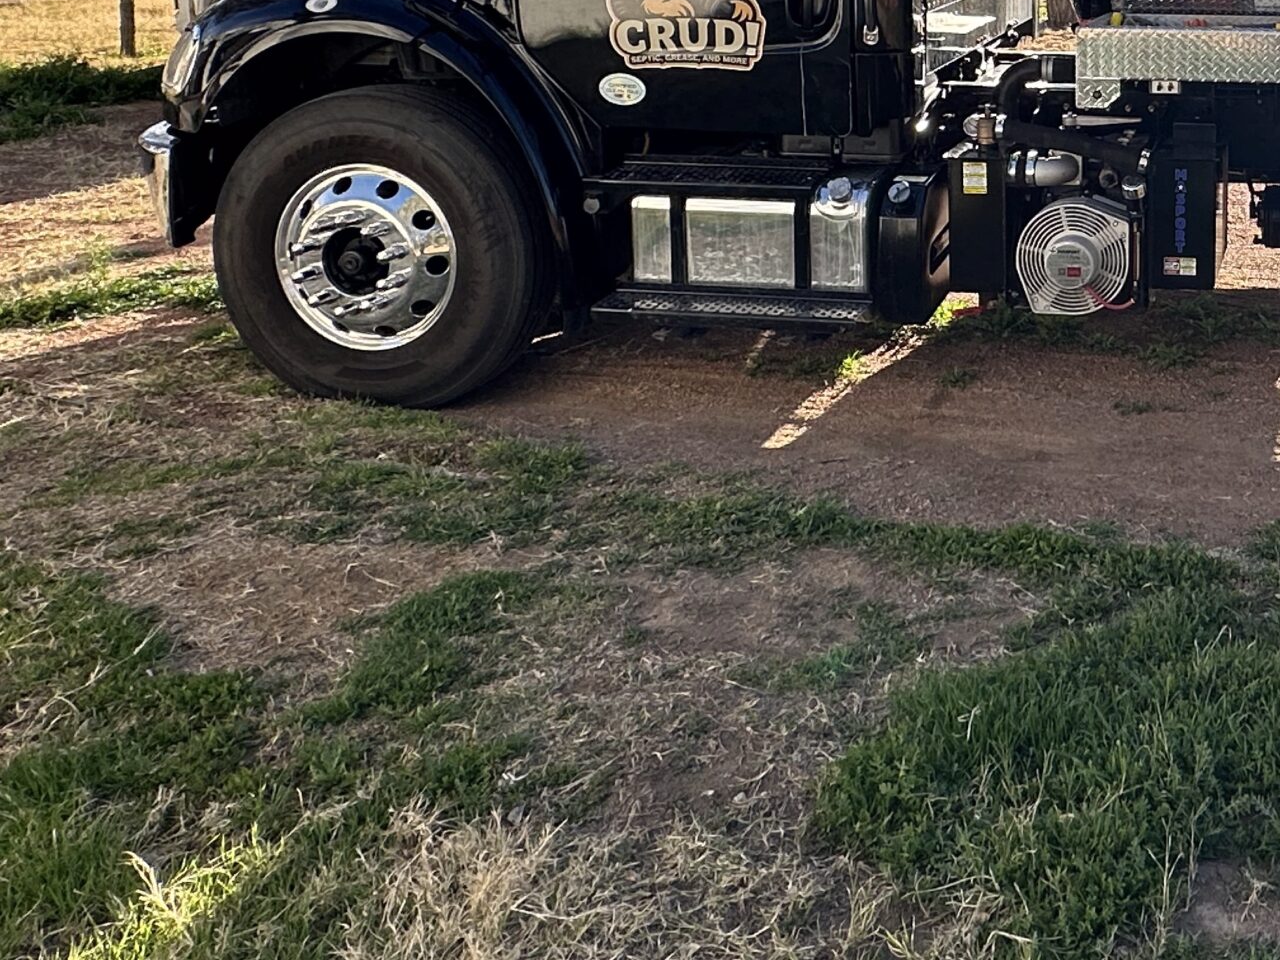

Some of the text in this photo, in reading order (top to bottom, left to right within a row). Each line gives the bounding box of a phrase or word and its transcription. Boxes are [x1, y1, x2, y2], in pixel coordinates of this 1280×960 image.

[615, 17, 760, 56] CRUD!
[702, 55, 721, 63] AND
[723, 56, 748, 65] MORE
